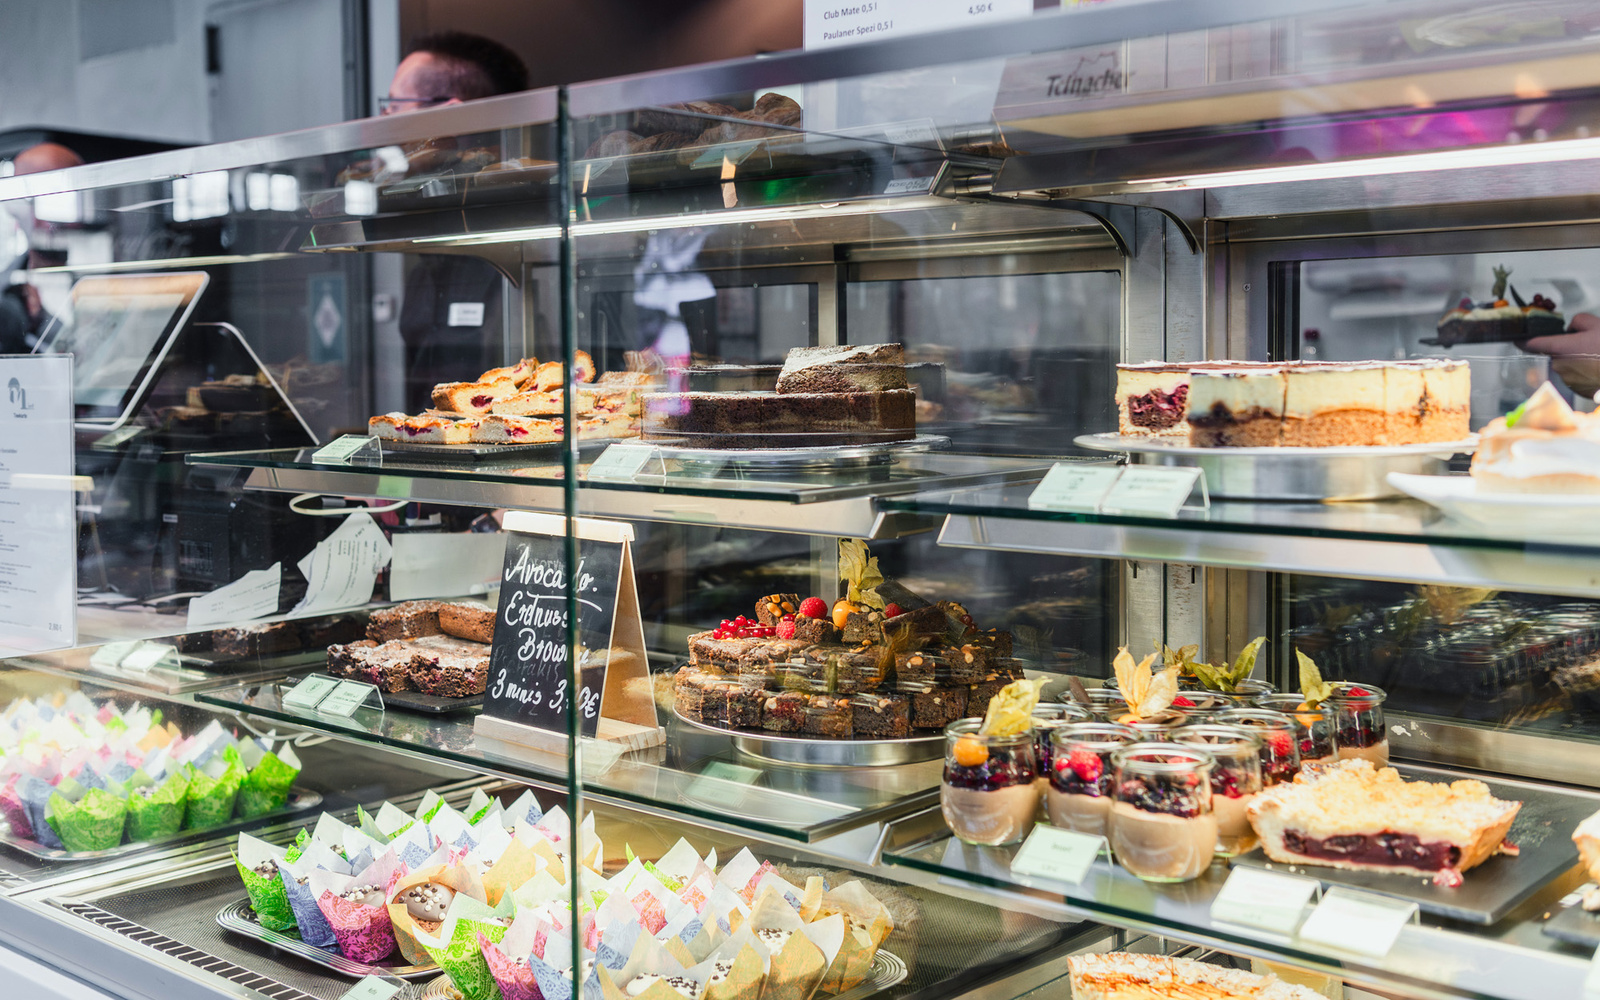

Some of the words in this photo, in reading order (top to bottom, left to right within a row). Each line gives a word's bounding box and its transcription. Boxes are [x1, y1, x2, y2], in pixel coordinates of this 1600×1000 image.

[823, 10, 840, 20] Club
[841, 7, 861, 16] Mate
[861, 3, 873, 13] 0,5
[823, 28, 855, 40] Paulaner
[856, 23, 876, 35] Spezi
[877, 21, 889, 31] 0,5
[491, 668, 507, 699] 3
[505, 677, 542, 705] minis
